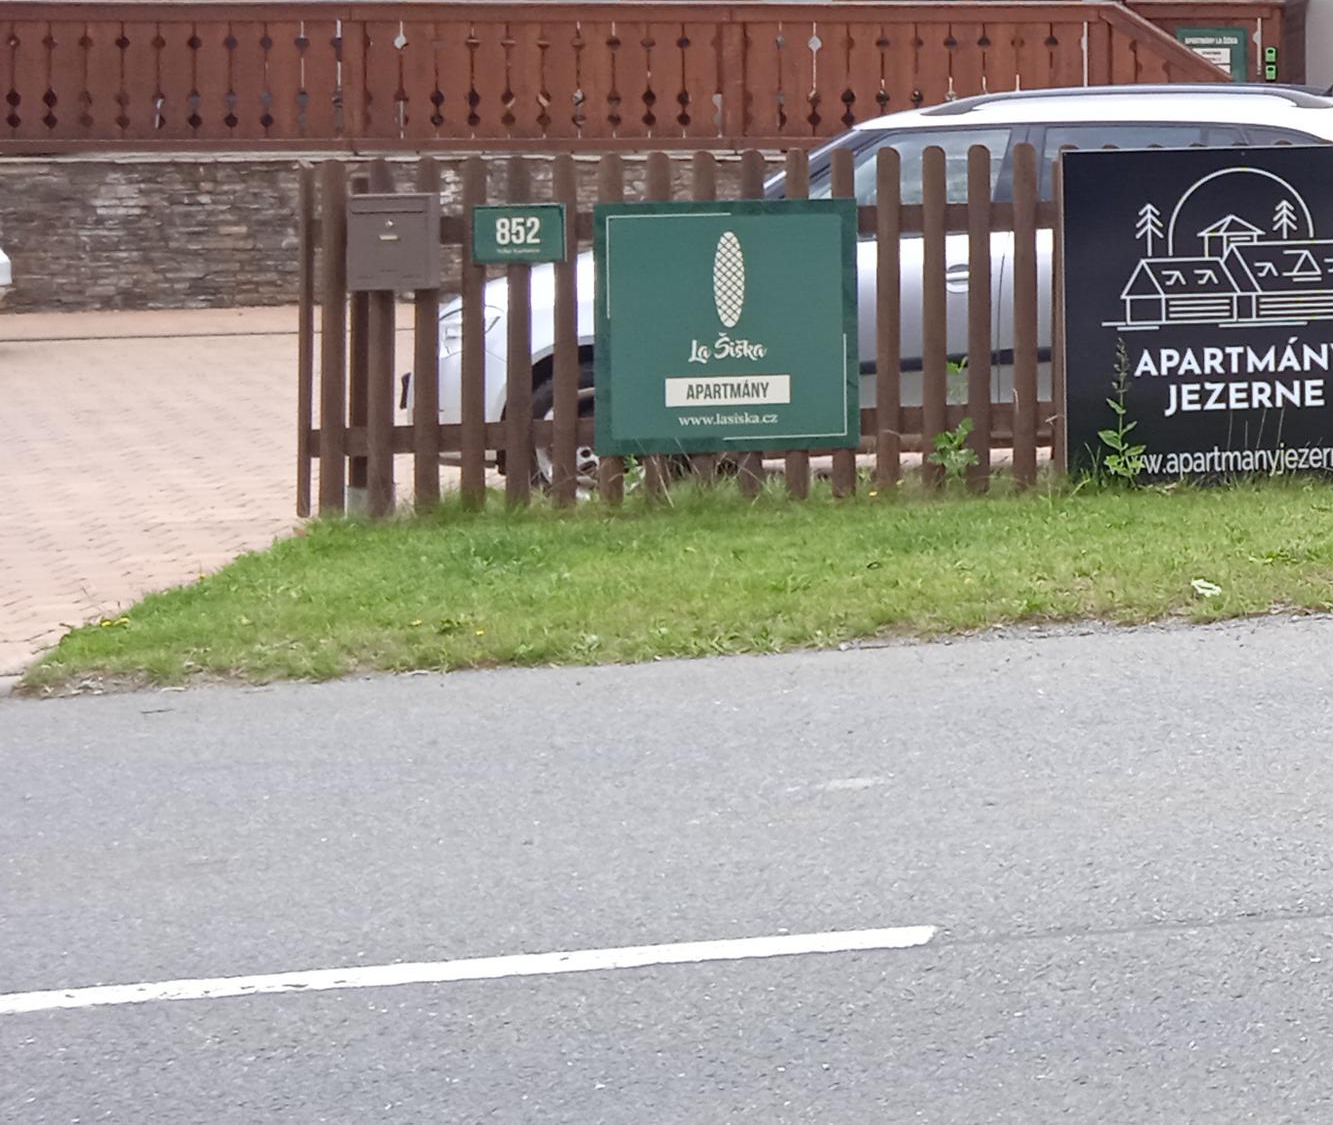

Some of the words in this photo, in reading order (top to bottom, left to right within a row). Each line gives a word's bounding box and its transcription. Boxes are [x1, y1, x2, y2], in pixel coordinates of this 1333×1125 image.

[495, 216, 540, 245] 852
[688, 338, 711, 364] La
[713, 332, 768, 361] Šiška
[685, 379, 769, 400] APARTMÁNY
[1163, 379, 1325, 417] JEZERNE
[678, 412, 778, 426] www.lasiska.cz
